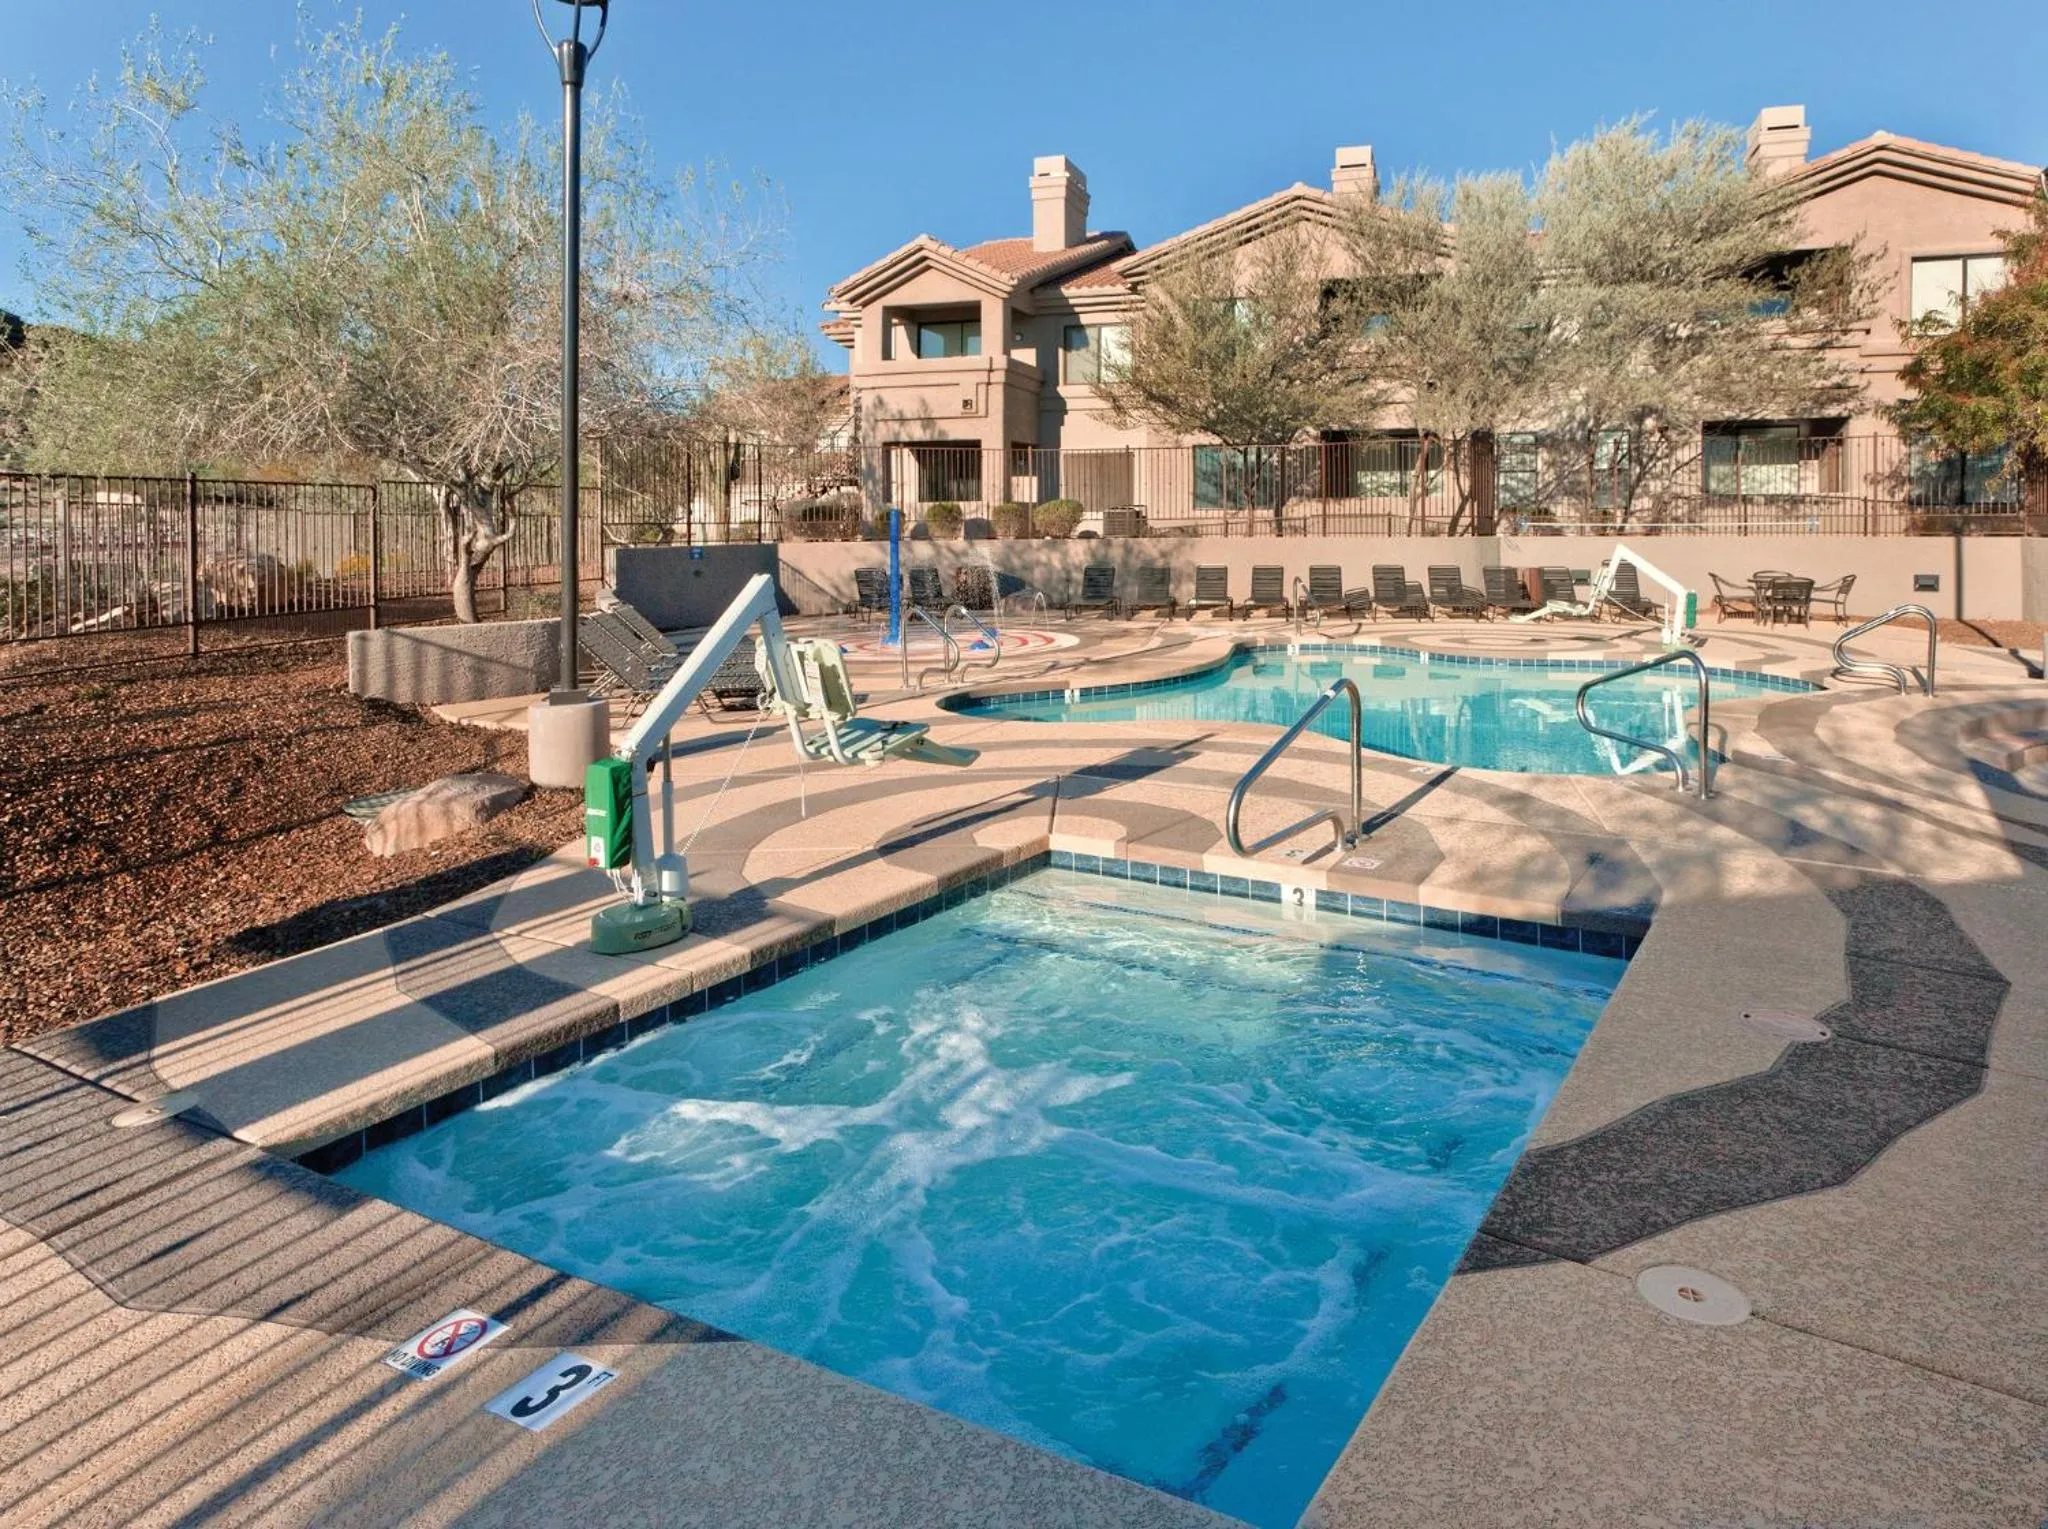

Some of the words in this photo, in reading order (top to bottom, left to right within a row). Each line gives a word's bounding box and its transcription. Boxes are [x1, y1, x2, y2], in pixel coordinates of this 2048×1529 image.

[387, 1348, 409, 1362] NO
[400, 1355, 441, 1377] DIVING
[510, 1364, 593, 1417] 3
[587, 1371, 614, 1388] FT
